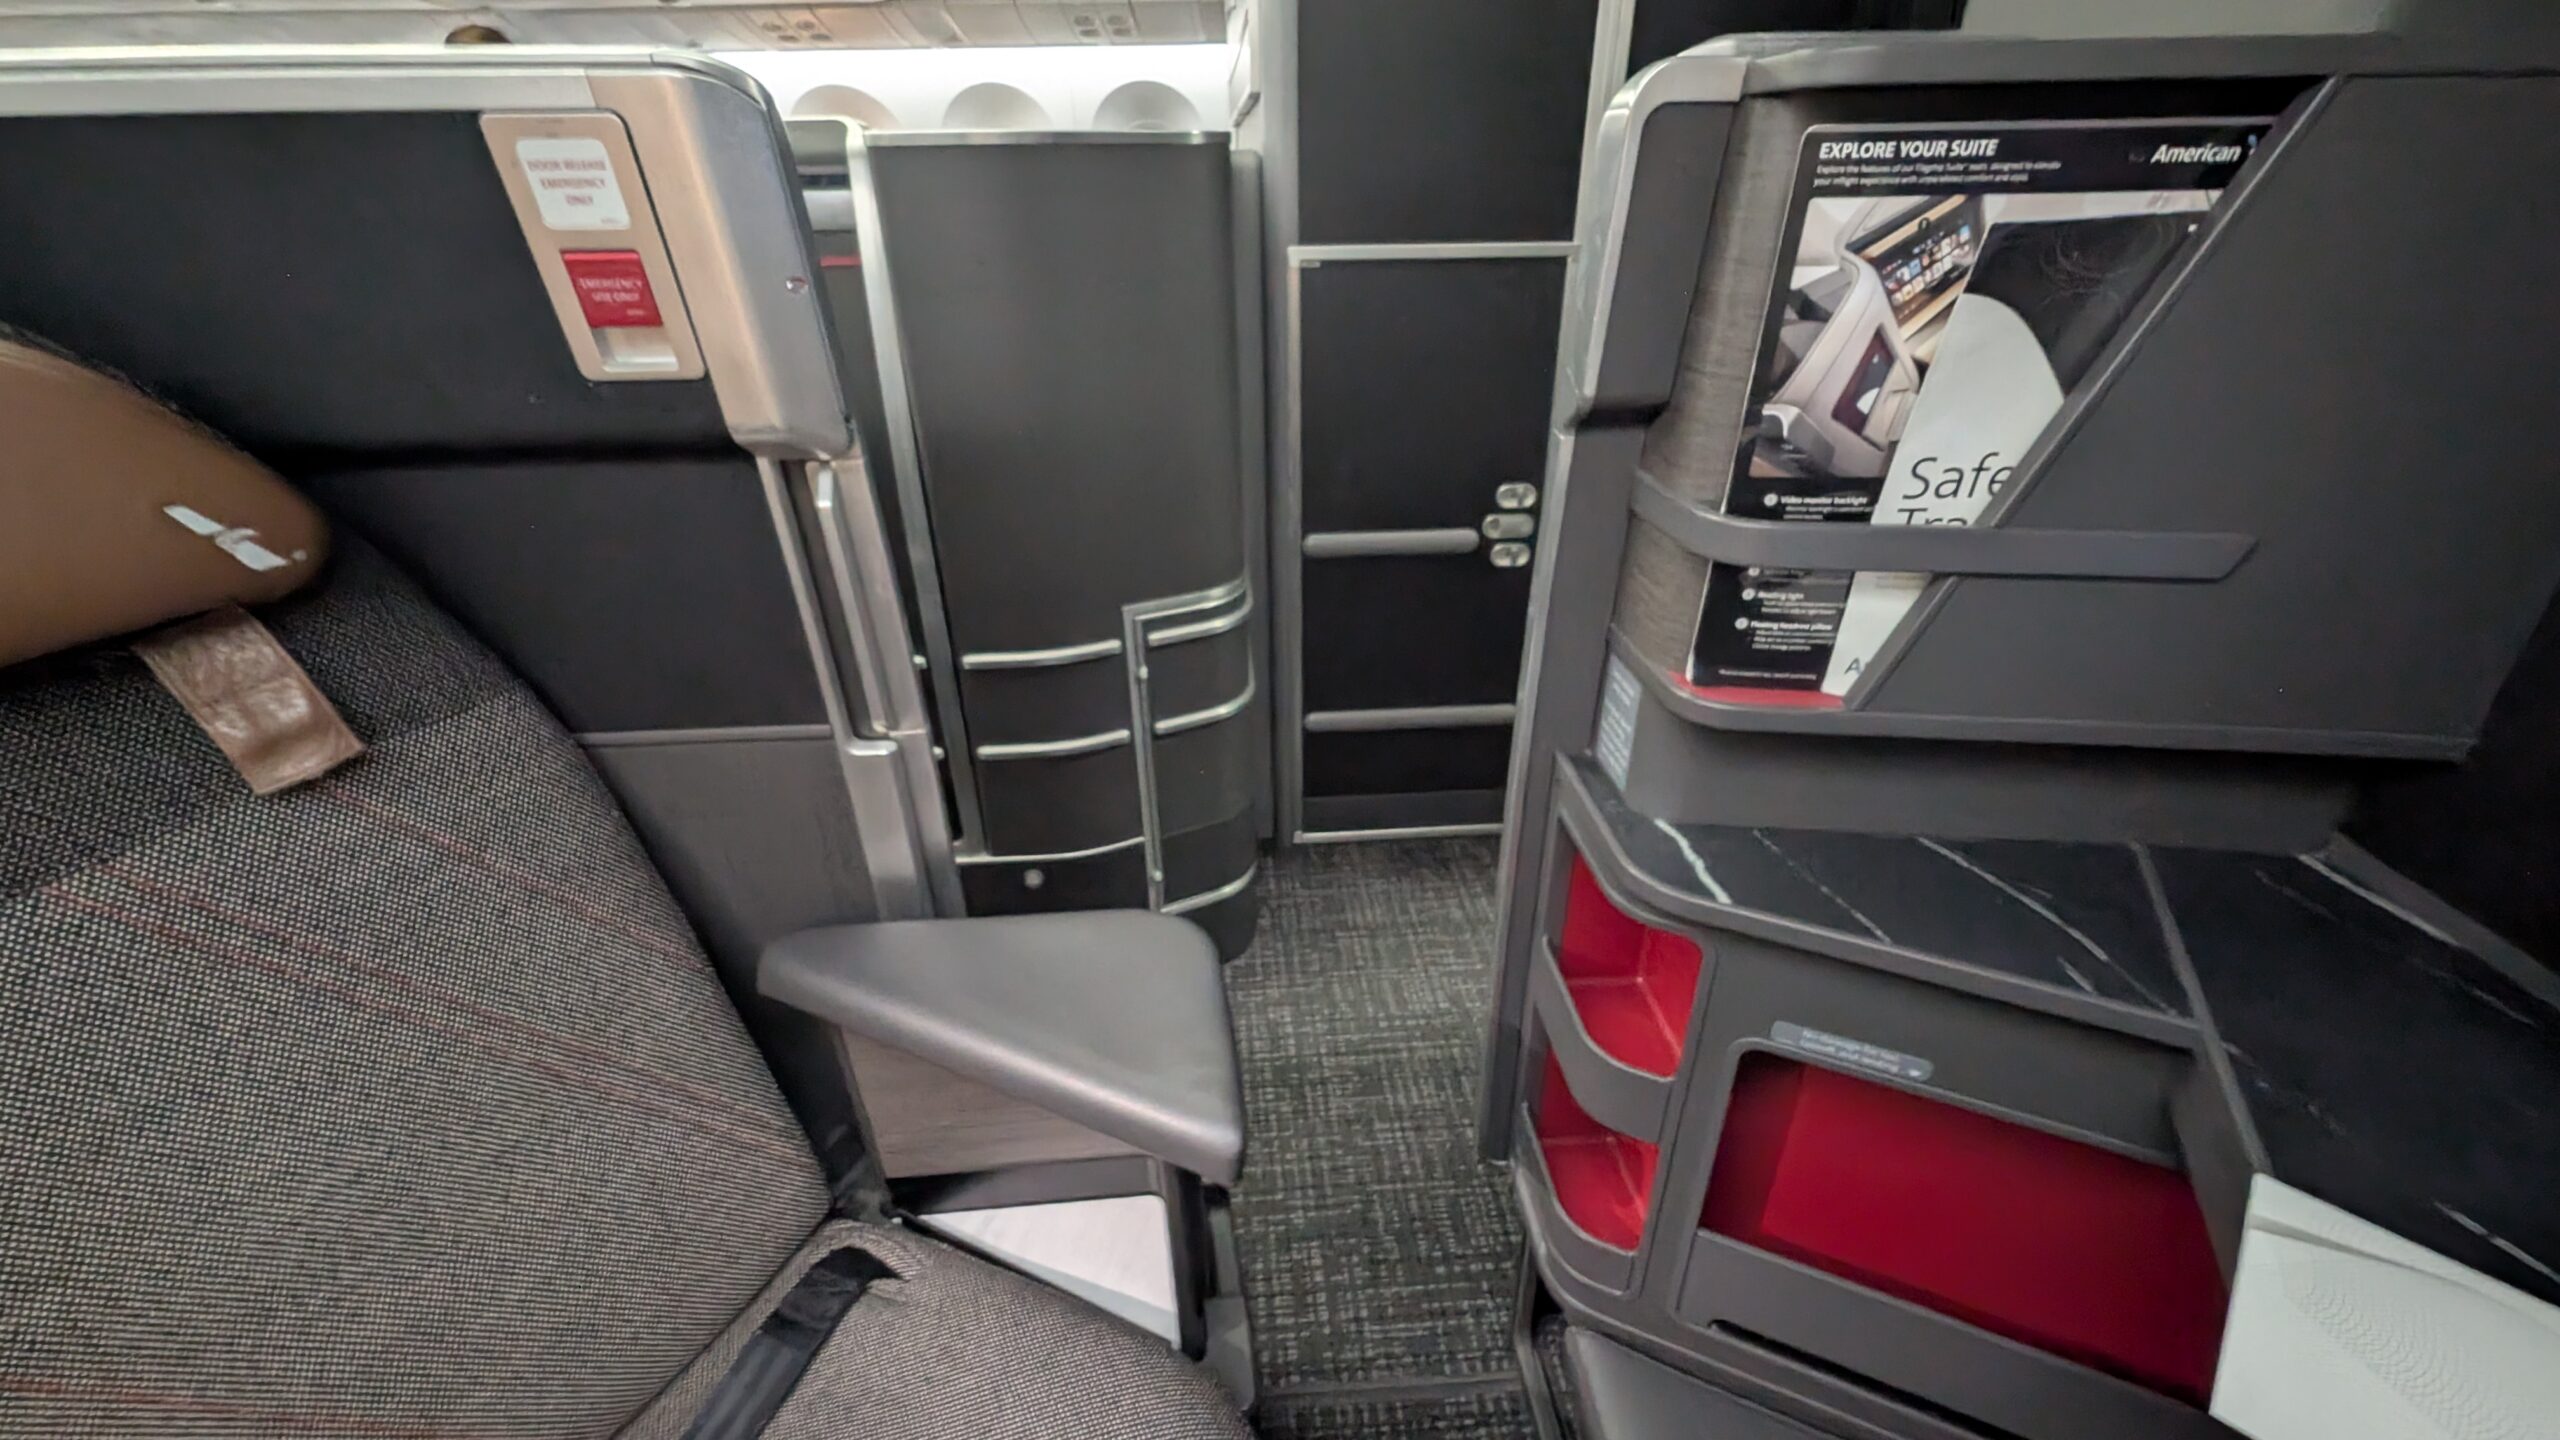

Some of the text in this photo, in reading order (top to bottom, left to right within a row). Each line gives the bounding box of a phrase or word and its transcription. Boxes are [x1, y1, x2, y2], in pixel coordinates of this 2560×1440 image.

[1819, 138, 1999, 159] EXPLORE YOUR SUITE
[2150, 143, 2242, 164] American
